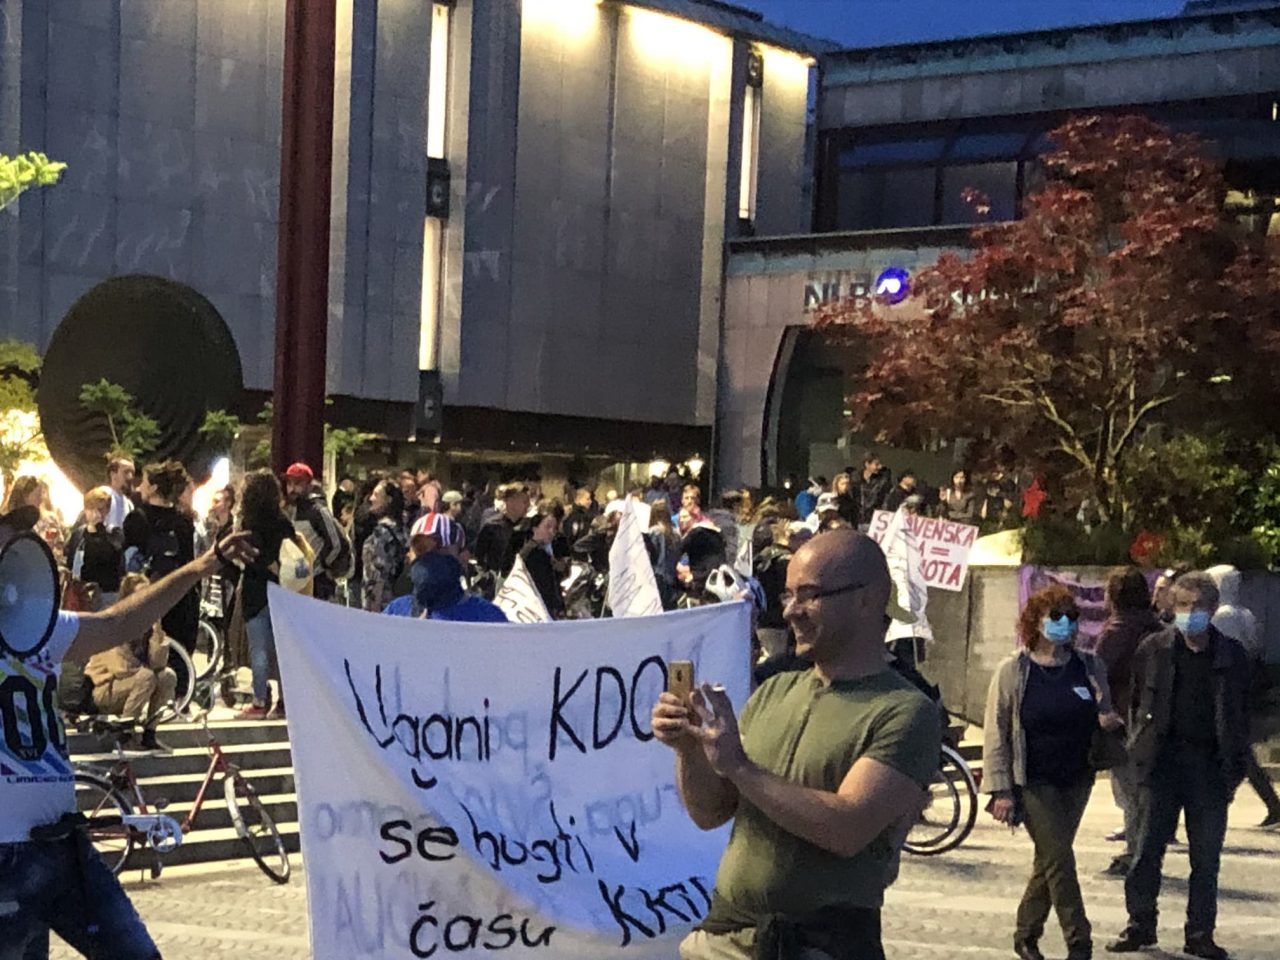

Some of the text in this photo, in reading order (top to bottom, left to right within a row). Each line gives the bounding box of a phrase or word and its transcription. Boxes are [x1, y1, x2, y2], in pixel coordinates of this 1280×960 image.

[342, 658, 492, 789] Ugani
[549, 655, 669, 762] KDO
[378, 818, 459, 864] se
